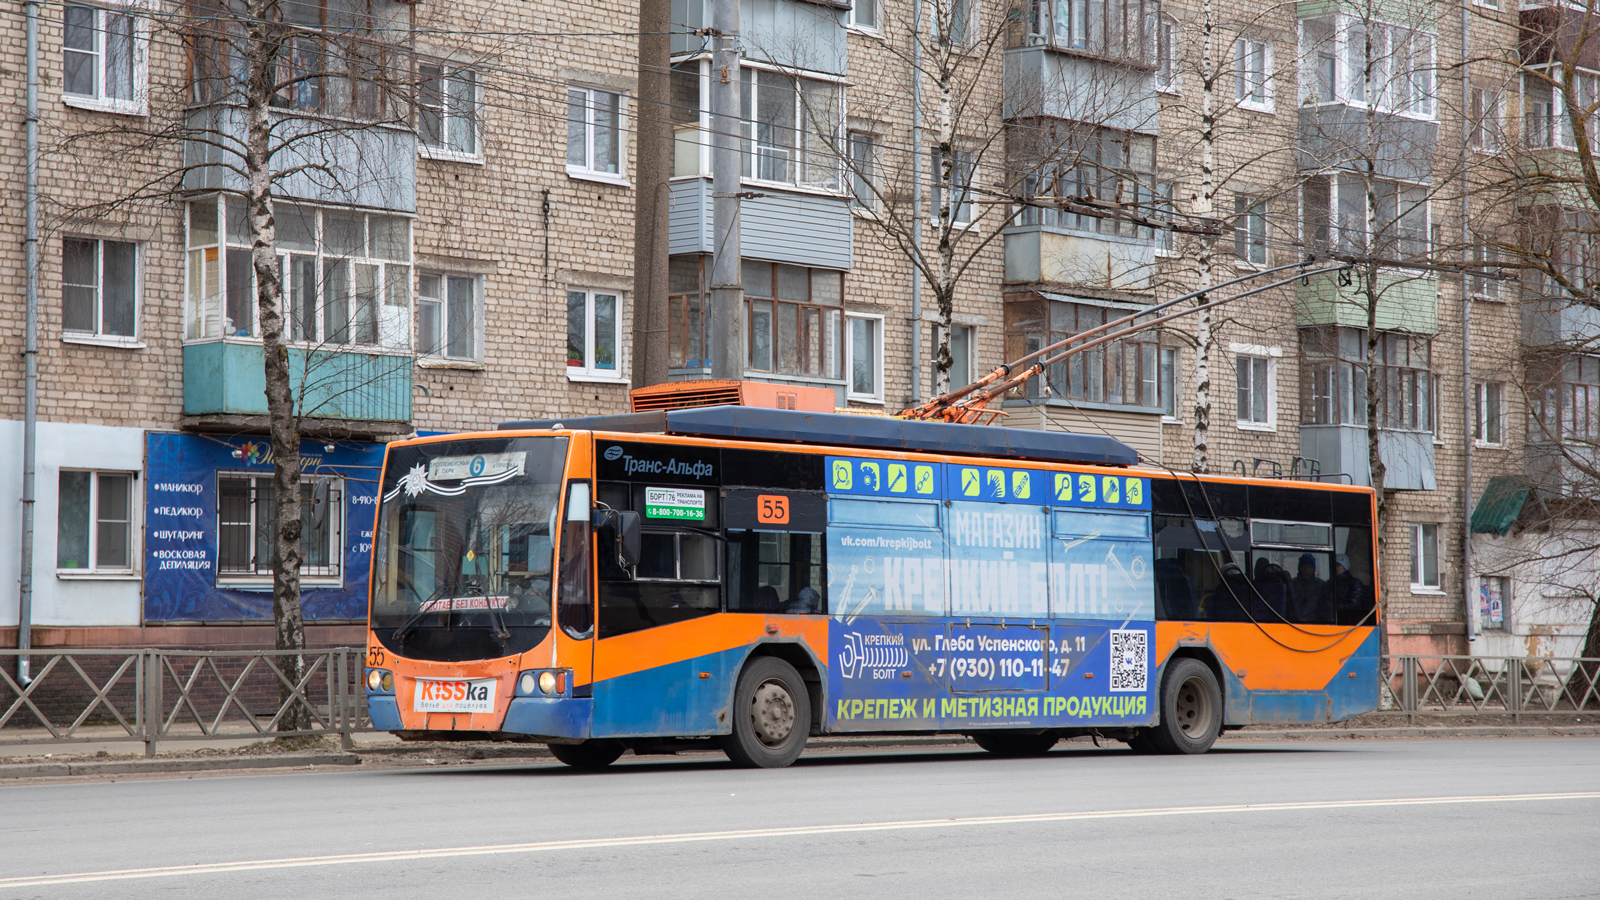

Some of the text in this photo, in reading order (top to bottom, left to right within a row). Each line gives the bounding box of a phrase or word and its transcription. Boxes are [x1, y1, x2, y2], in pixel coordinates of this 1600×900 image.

[472, 457, 482, 474] 6
[622, 455, 714, 480] Транс-Альфа
[160, 483, 204, 496] МАНИКЮР
[650, 492, 676, 502] БОРТ 76
[160, 506, 204, 519] ПЕДИКЮР
[652, 507, 704, 518] 8-800-700-16-36
[762, 499, 786, 520] 55
[160, 530, 205, 542] ШУГАРИНГ
[956, 511, 1041, 549] МАГАЗИН
[841, 535, 932, 551] vk.com/krepkijbolt
[159, 550, 206, 559] ВОСКОВАЯ
[159, 560, 211, 570] ДЕПИЛЯЦИЯ
[884, 551, 1108, 614] КРЕПКИЙ БОЛТ!
[455, 598, 468, 609] БЕЗ
[864, 633, 904, 646] КРЕПКИЙ
[912, 634, 1086, 655] ул. Глеба Успенского, д. 11
[369, 646, 385, 666] 55
[873, 669, 896, 679] БОЛТ
[928, 657, 1070, 681] +7 (930) 110-11-47
[420, 701, 440, 709] белье
[455, 702, 487, 710] поцелуев
[837, 696, 1147, 720] КРЕПЕЖ И МЕТИЗНАЯ ПРОДУКЦИЯ
